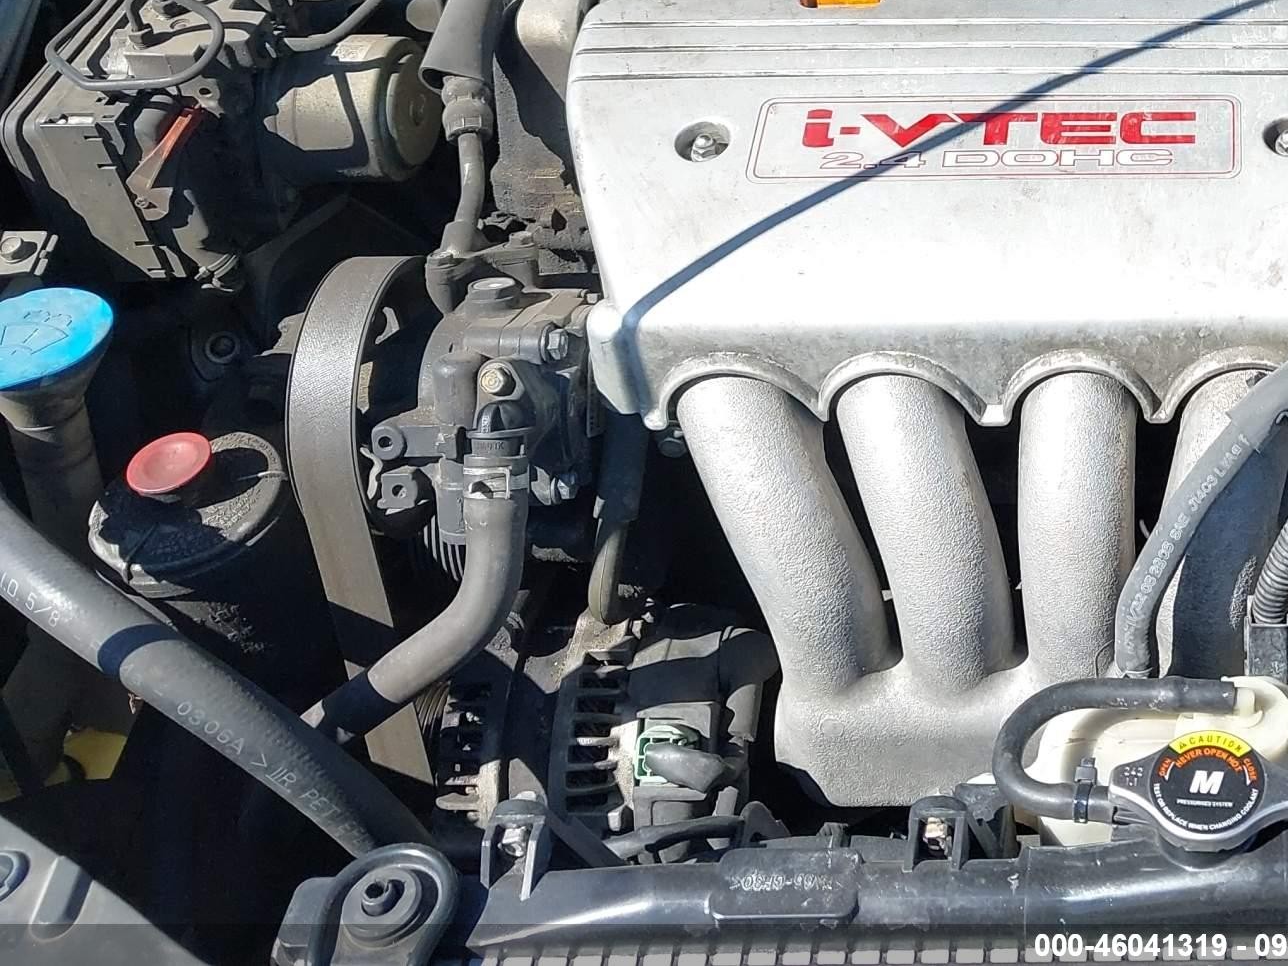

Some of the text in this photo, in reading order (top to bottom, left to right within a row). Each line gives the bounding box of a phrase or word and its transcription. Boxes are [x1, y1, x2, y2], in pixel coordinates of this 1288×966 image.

[802, 108, 1197, 148] i-VTEC
[819, 148, 1174, 170] 2.4 DOHC
[176, 700, 245, 756] 0306A
[1188, 735, 1243, 753] CAUTION
[1176, 748, 1202, 768] NEVER
[1203, 746, 1228, 762] OPEN
[1189, 770, 1224, 795] M
[1162, 806, 1189, 828] REPLACE
[1187, 822, 1209, 831] WHEN
[1208, 812, 1242, 831] CHANGING
[1240, 787, 1260, 815] COOLANT
